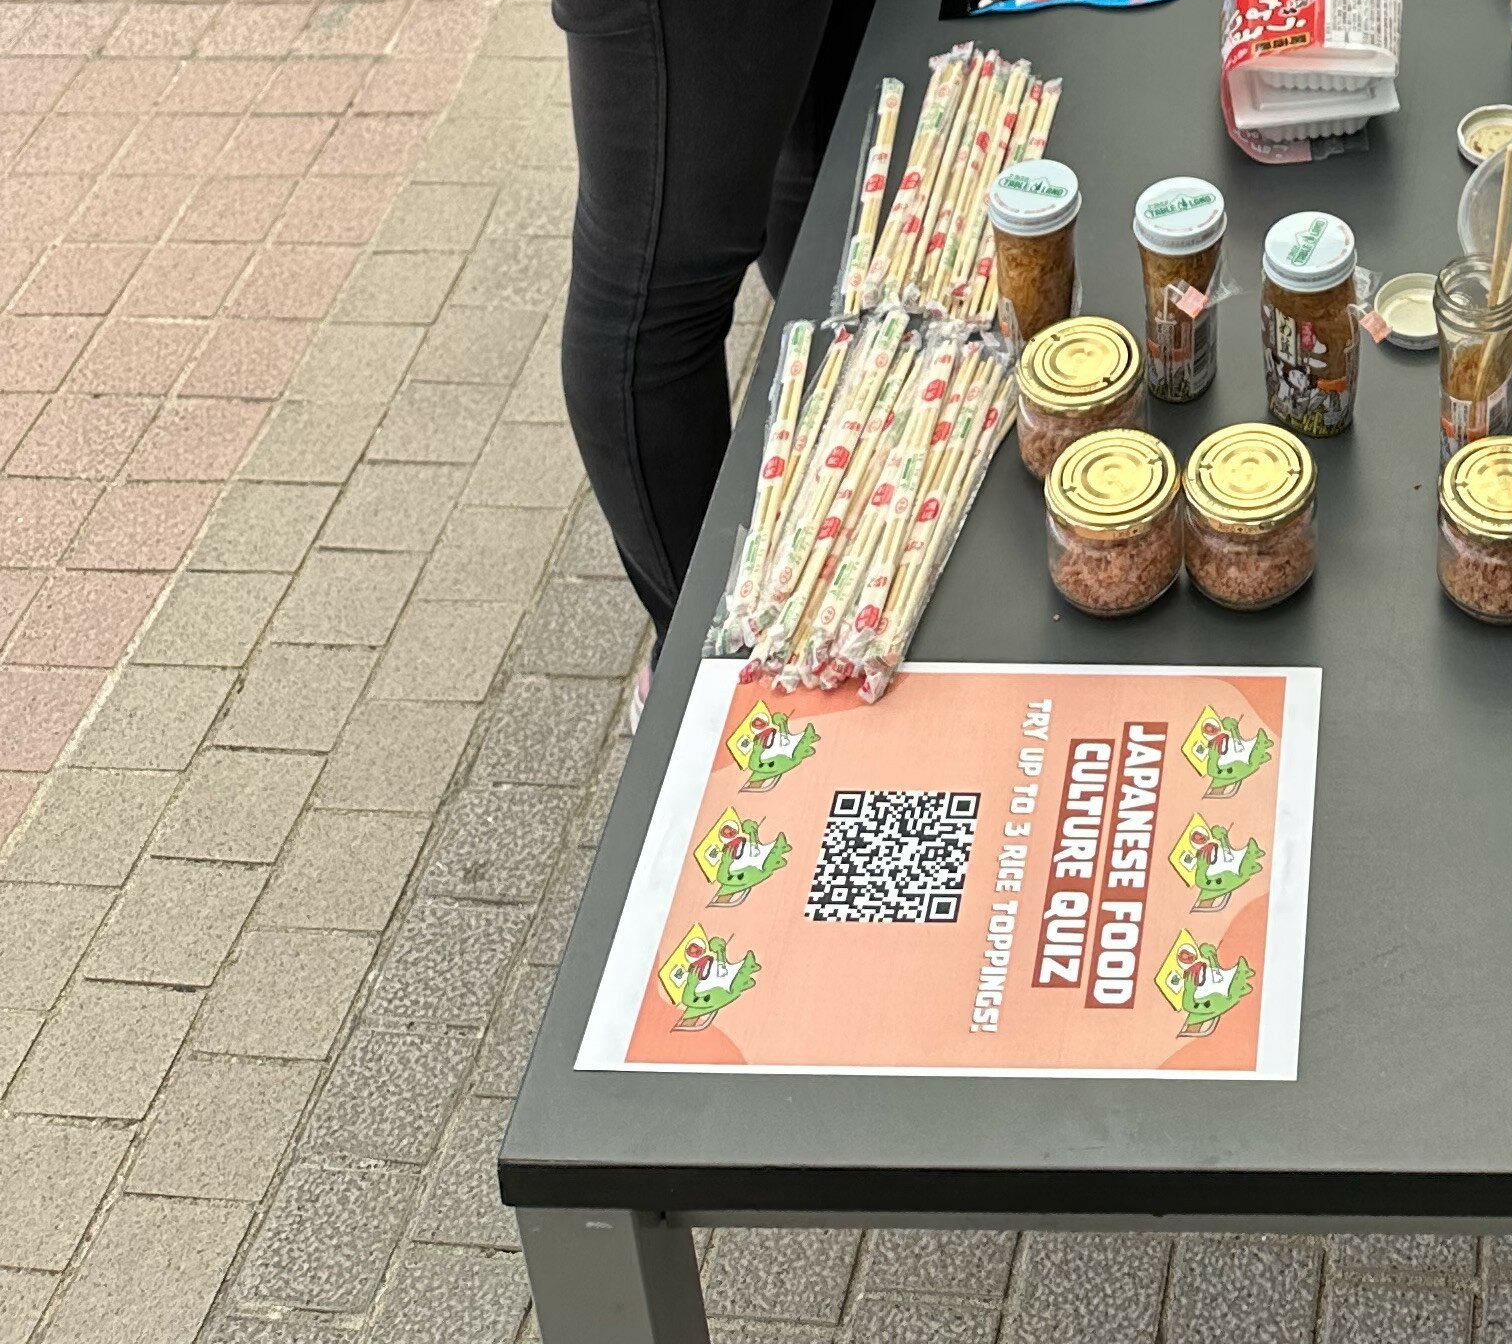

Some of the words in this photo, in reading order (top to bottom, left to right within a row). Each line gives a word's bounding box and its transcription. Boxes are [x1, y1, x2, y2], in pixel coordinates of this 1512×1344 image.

[1149, 202, 1176, 217] TABLE
[1022, 698, 1052, 741] TRY
[1016, 746, 1045, 777] UP
[1009, 783, 1039, 815] TO
[1051, 741, 1113, 880] CULTURE
[1106, 724, 1167, 890] JAPANESE
[1003, 821, 1031, 838] 3
[995, 844, 1029, 893] RICE
[1038, 890, 1090, 984] QUIZ
[1093, 900, 1143, 1005] FOOD
[969, 899, 1020, 1034] TOPPINGS!
